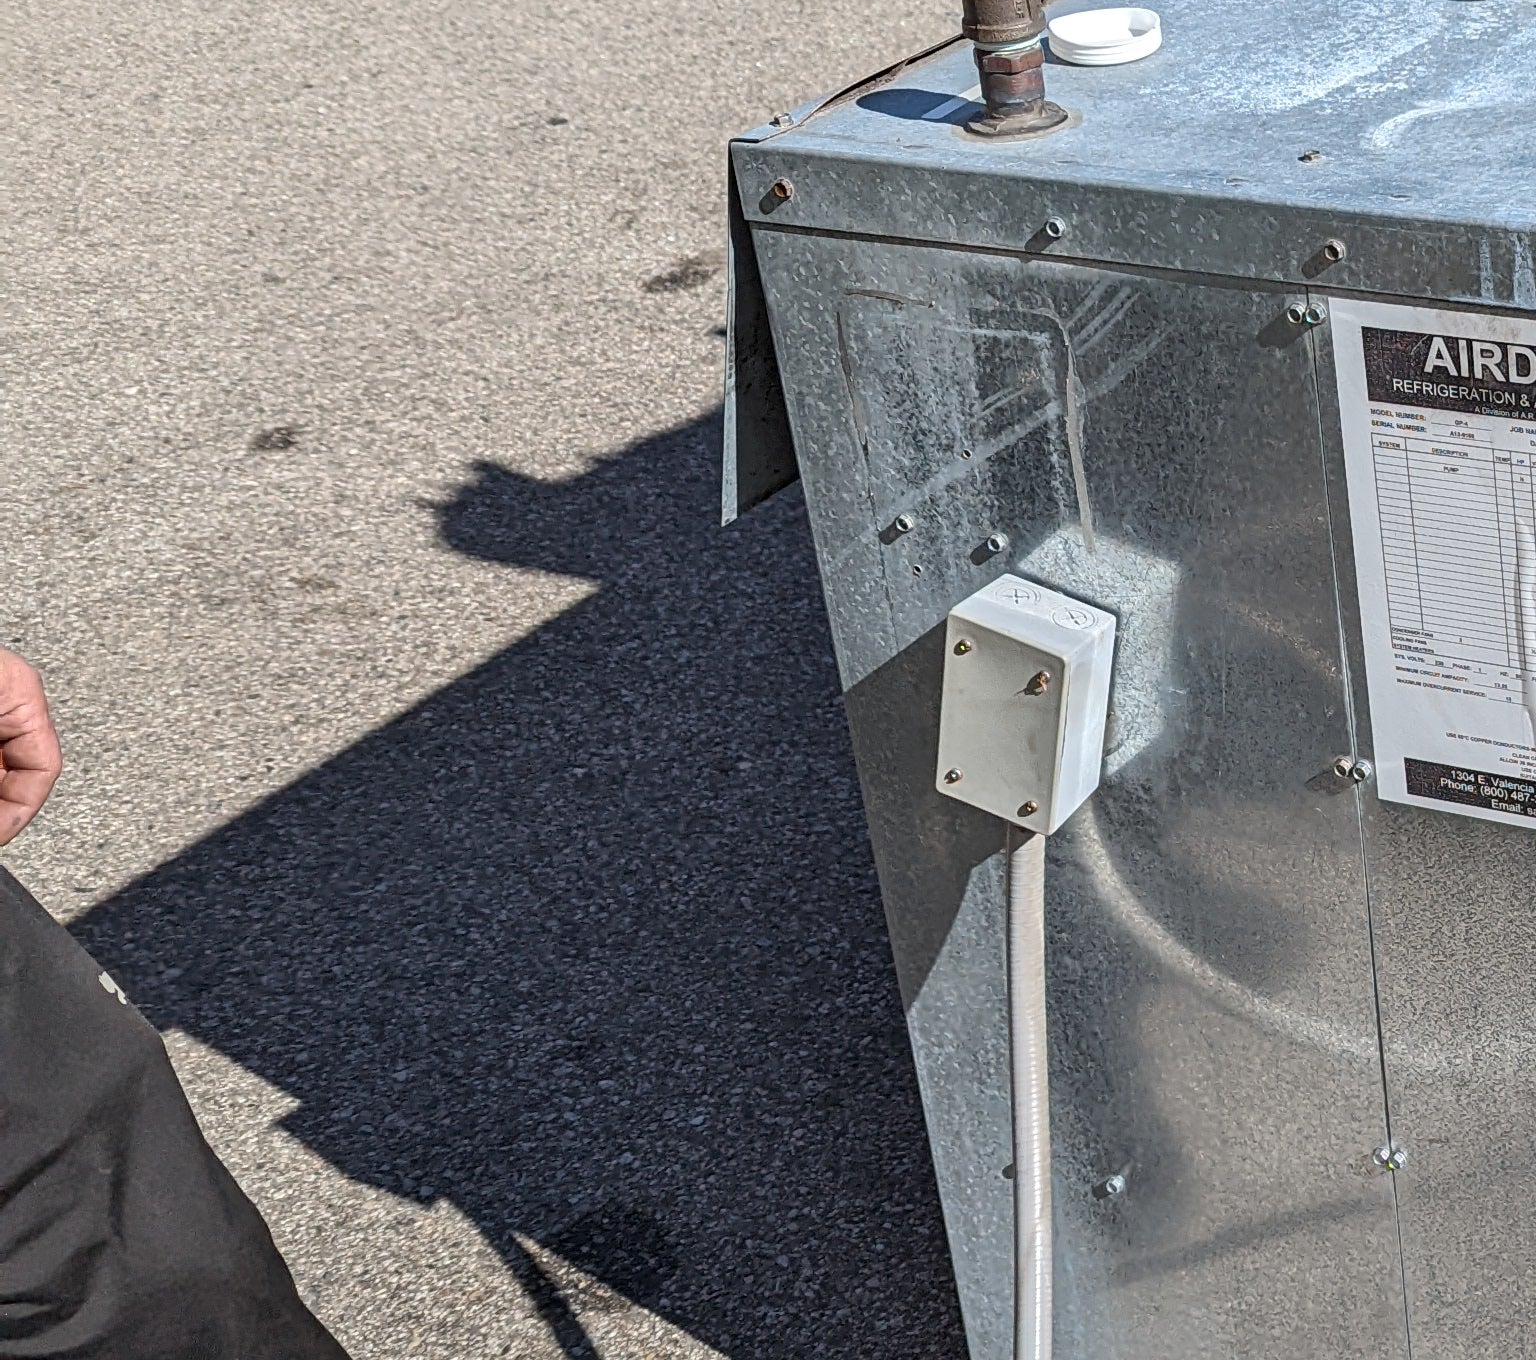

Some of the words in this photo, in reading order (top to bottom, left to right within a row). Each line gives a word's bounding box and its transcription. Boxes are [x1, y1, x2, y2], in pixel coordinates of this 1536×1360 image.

[1392, 378, 1516, 406] REFRIGERATION
[1519, 394, 1530, 408] &
[1370, 408, 1394, 418] MODEL
[1482, 406, 1511, 417] Division
[1371, 420, 1395, 429] SERIAL
[1510, 426, 1524, 434] JOB
[1450, 770, 1475, 782] 1304
[1477, 774, 1489, 785] E.
[1490, 776, 1535, 794] Valencia
[1440, 777, 1478, 794] Phone:
[1479, 784, 1509, 801] (800)
[1491, 799, 1525, 814] Email:
